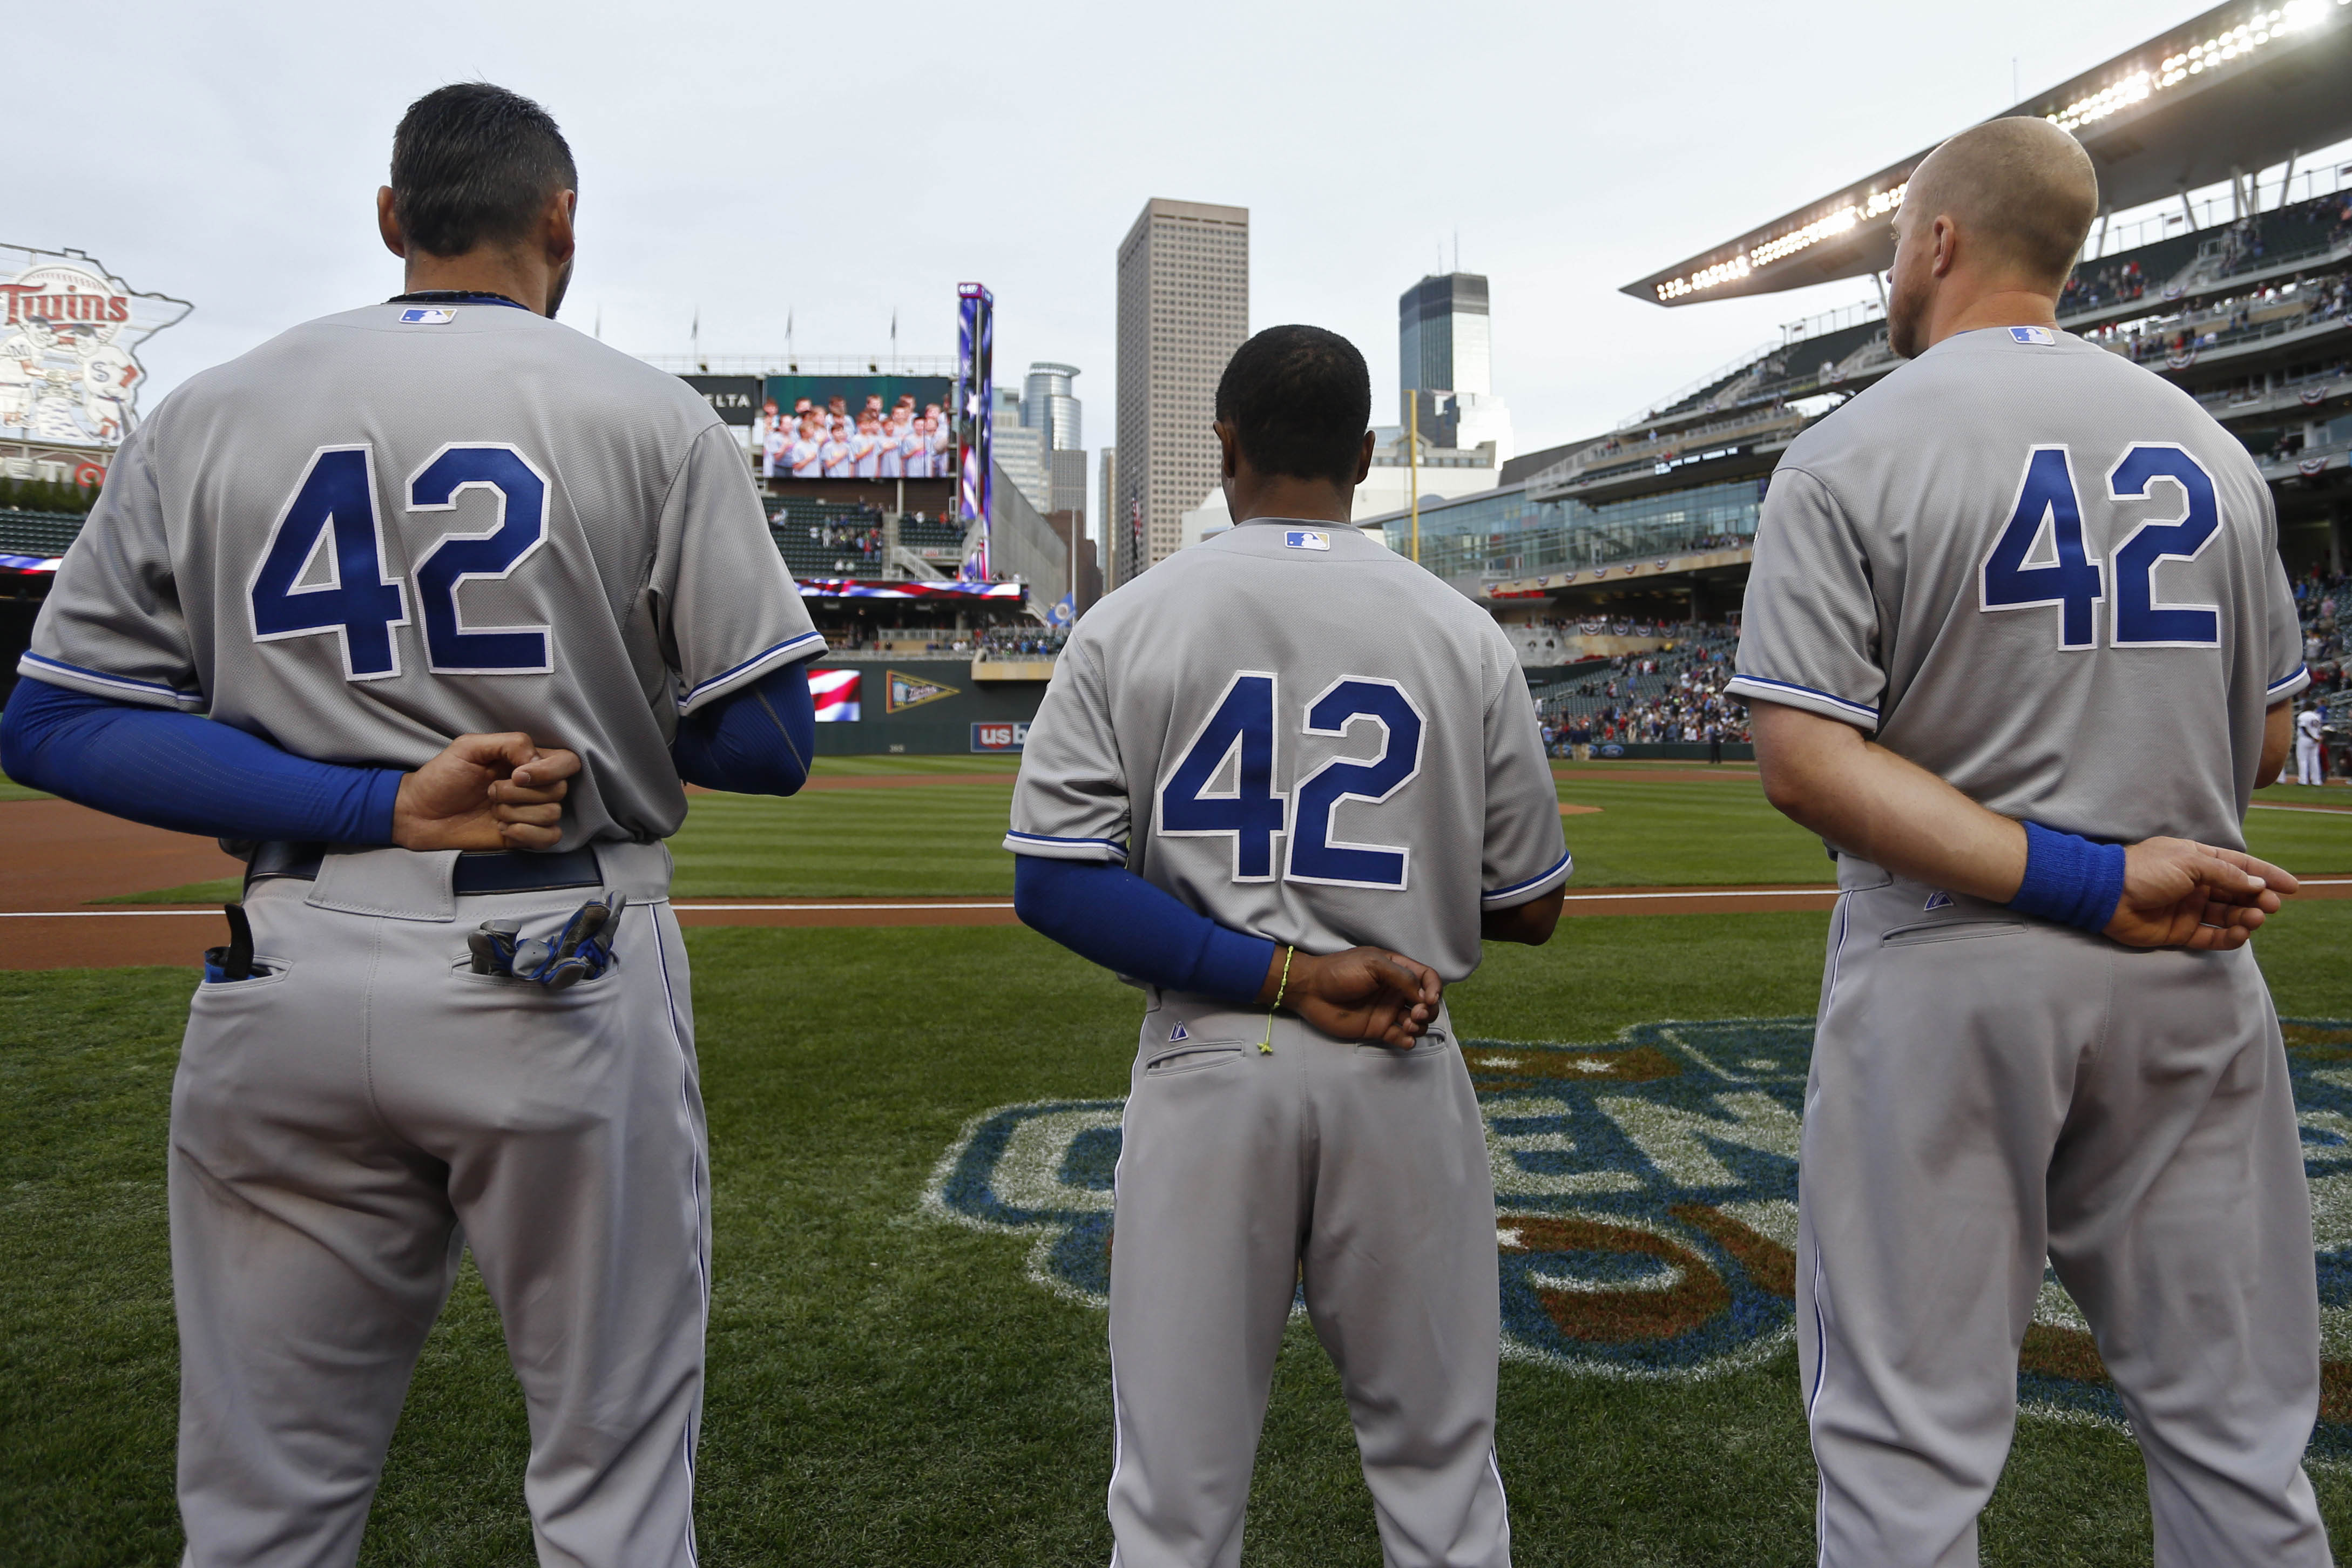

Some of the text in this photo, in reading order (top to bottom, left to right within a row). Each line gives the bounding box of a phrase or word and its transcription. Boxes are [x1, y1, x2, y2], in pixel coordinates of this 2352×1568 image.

[0, 283, 129, 325] Twins
[91, 361, 110, 382] S
[702, 393, 751, 408] ELTA
[0, 457, 69, 482] ET
[246, 442, 554, 681] 42
[1979, 441, 2221, 651] 42
[981, 724, 1028, 745] usb
[1157, 670, 1427, 891] 42
